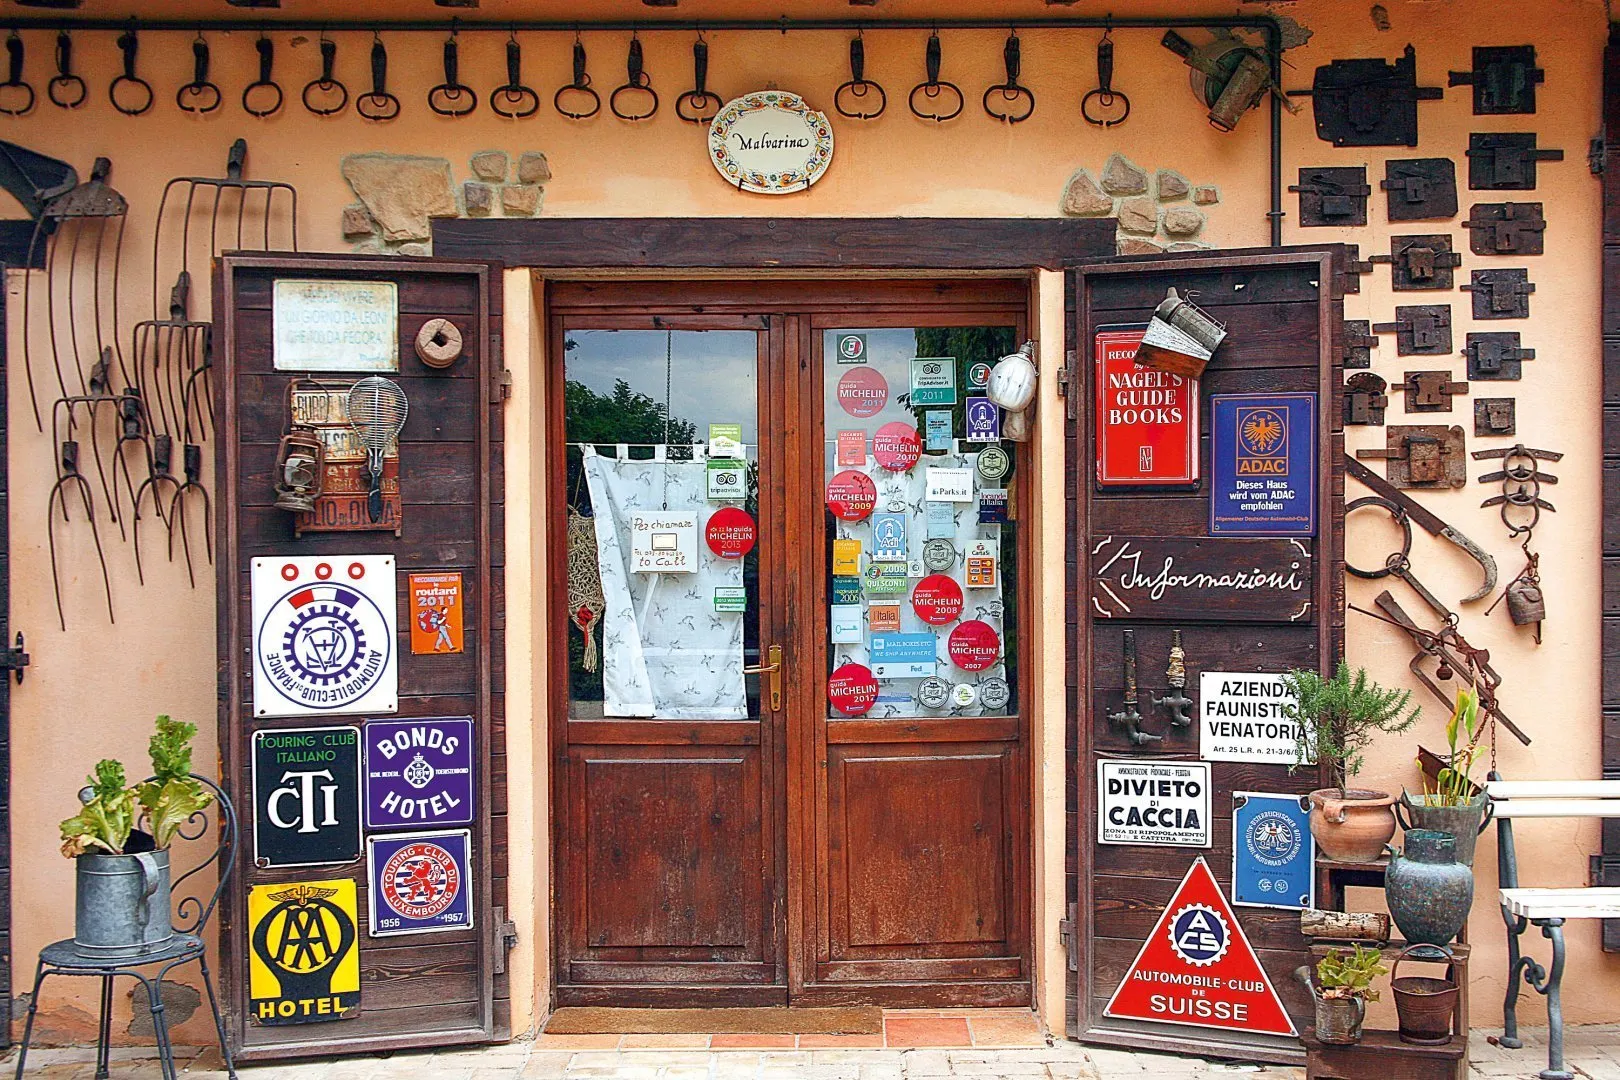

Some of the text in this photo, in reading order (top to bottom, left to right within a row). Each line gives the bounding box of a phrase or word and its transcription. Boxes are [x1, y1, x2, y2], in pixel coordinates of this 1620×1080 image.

[732, 132, 809, 150] Malvarina
[1109, 371, 1183, 389] NAGEL'S
[840, 389, 886, 398] MICHELIN
[922, 391, 944, 400] 2011
[1116, 389, 1176, 407] GUIDE
[862, 399, 884, 407] 2011
[1109, 407, 1183, 425] BOOKS
[973, 420, 993, 430] Adi
[874, 443, 919, 453] MICHELIN
[896, 453, 918, 461] 2010
[1239, 459, 1285, 473] ADAC
[1236, 480, 1288, 489] Dieses Haus
[828, 493, 875, 501] MICHELIN
[939, 487, 967, 496] Parks.it
[1229, 490, 1295, 500] wird vom ADAC
[849, 502, 872, 510] 2009
[1240, 501, 1283, 512] empfohlen
[709, 532, 753, 540] MICHELIN
[721, 540, 742, 549] 2013
[881, 537, 899, 547] Adi
[639, 556, 651, 567] to
[1121, 550, 1302, 600] Informazioni
[415, 586, 458, 597] routard
[417, 596, 455, 607] 2011
[915, 598, 961, 606] MICHELIN
[935, 606, 958, 614] 2008
[951, 647, 996, 655] MICHELIN
[266, 652, 298, 692] FRANCE
[830, 684, 877, 697] MICHELIN
[260, 733, 357, 749] TOURING CLUB
[376, 726, 459, 760] BONDS
[1213, 745, 1226, 753] Art.
[276, 750, 337, 763] ITALIANO
[1108, 778, 1201, 798] DIVIETO
[380, 790, 461, 819] HOTEL
[1108, 806, 1201, 829] CACCIA
[1138, 830, 1205, 838] RIPOPOLAMENTO
[384, 846, 457, 889] TOURING CLUB DU
[389, 890, 453, 916] LUXEMBOURG
[380, 918, 401, 929] 1956
[1191, 988, 1206, 996] DE
[258, 996, 348, 1019] HOTEL
[1150, 994, 1248, 1021] SUISSE
